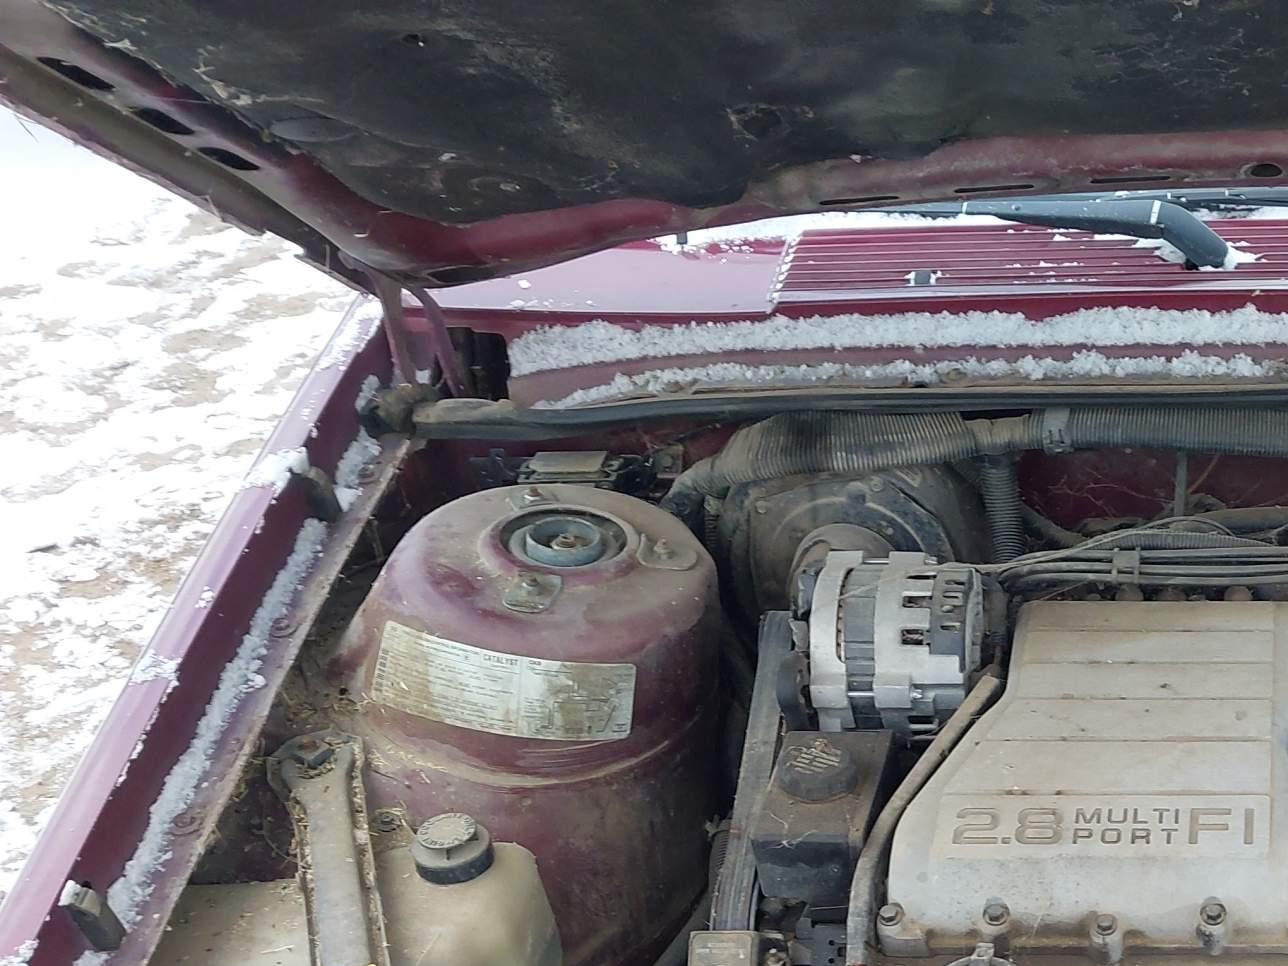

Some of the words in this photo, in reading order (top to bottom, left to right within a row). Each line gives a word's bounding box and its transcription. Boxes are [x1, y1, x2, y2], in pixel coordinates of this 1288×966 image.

[952, 807, 1064, 845] 2.8
[1074, 808, 1180, 825] MULTI
[1188, 807, 1255, 845] FI
[1072, 828, 1179, 845] PORT
